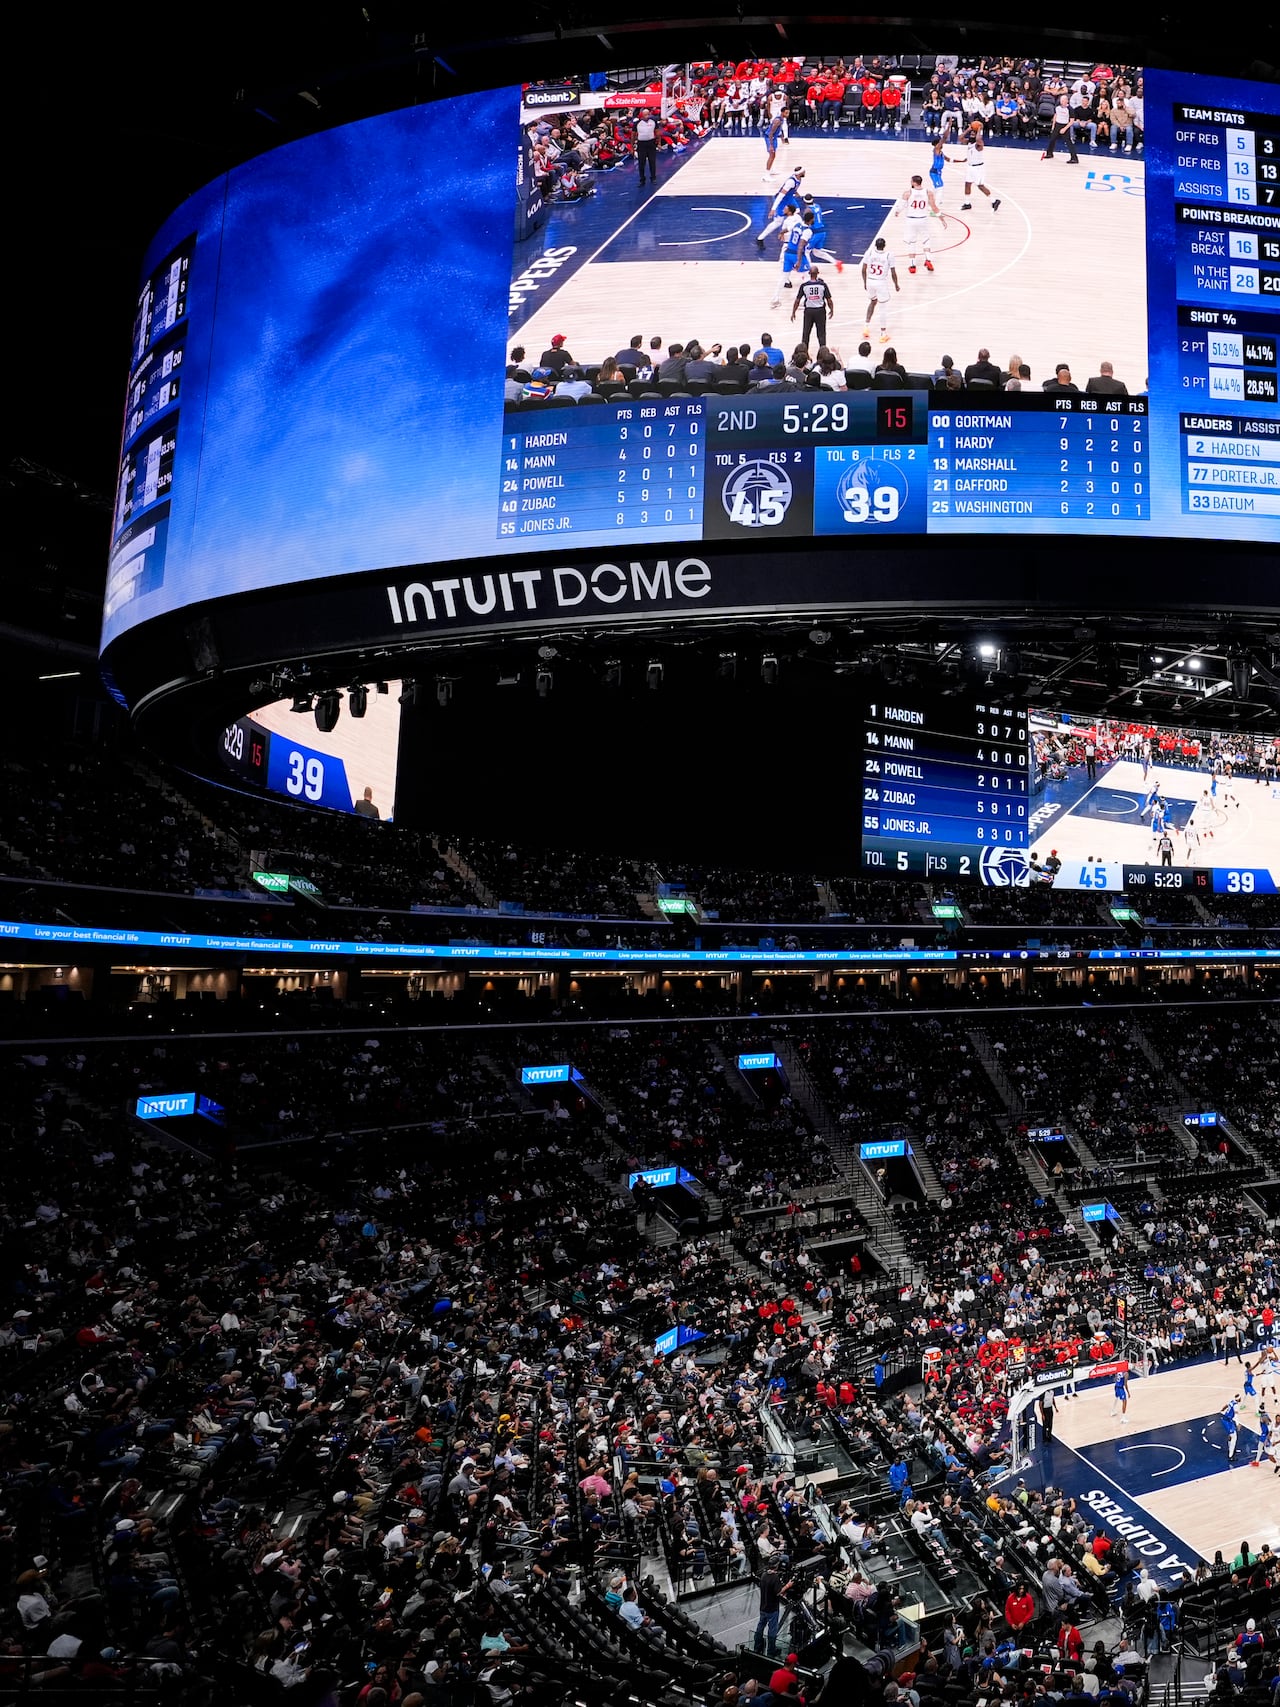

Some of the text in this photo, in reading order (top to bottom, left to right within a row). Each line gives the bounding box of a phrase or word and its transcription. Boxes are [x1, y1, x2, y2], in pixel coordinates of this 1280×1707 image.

[526, 90, 570, 106] Globant
[1182, 107, 1245, 125] TEAM STATS
[1175, 131, 1273, 154] OFF REB 5 3
[1178, 156, 1277, 179] DEF REB 13 13
[1178, 182, 1274, 203] ASSISTS 15 7
[910, 199, 927, 211] 40
[1182, 209, 1221, 222] POINTS
[1198, 231, 1225, 243] FAST
[1191, 240, 1279, 258] BREAK 16 15
[869, 263, 885, 277] 55
[1193, 265, 1228, 278] IN THE
[1197, 278, 1228, 290] PAINT
[1236, 275, 1254, 288] 28
[808, 286, 820, 297] 38
[1190, 311, 1236, 325] SHOT %
[717, 402, 907, 434] 2ND 5:29 15
[932, 414, 1011, 429] 00 GORTMAN
[1184, 417, 1233, 431] LEADERS
[525, 433, 568, 448] HARDEN
[955, 436, 994, 450] HARDY
[827, 449, 860, 463] TOL 6
[883, 448, 916, 461] FLS 2
[1195, 441, 1204, 453] 2
[1211, 442, 1260, 457] HARDEN
[506, 455, 556, 471] 14 MANN
[715, 453, 746, 466] TOL 5
[769, 451, 802, 465] FLS 2
[933, 457, 1017, 472] 13 MARSHALL
[503, 476, 565, 493] 24 POWELL
[1192, 468, 1208, 481] 77
[1212, 469, 1258, 484] PORTER
[1259, 472, 1278, 485] JR.
[933, 479, 1008, 492] 21 GAFFORD
[501, 496, 556, 513] 40 ZUBAC
[729, 490, 785, 527] 45
[843, 486, 899, 523] 39
[932, 500, 1033, 514] 25 WASHINGTON
[1192, 495, 1210, 508] 33
[1213, 496, 1255, 511] BATUM
[500, 517, 573, 535] 55 JONES JR.
[386, 569, 542, 624] INTUIT
[252, 742, 325, 801] 15 39
[884, 762, 924, 780] POWELL
[882, 790, 916, 806] ZUBAC
[882, 818, 915, 834] JONES
[1078, 865, 1255, 893] 45 2ND 5:29 39
[35, 928, 191, 945] Live your best financial life INTUIT
[310, 943, 341, 951] INTUIT
[743, 1056, 770, 1067] INTUIT
[865, 1143, 900, 1157] INTUIT
[1036, 1369, 1067, 1383] Globant
[1079, 1489, 1168, 1556] CLIPPERS
